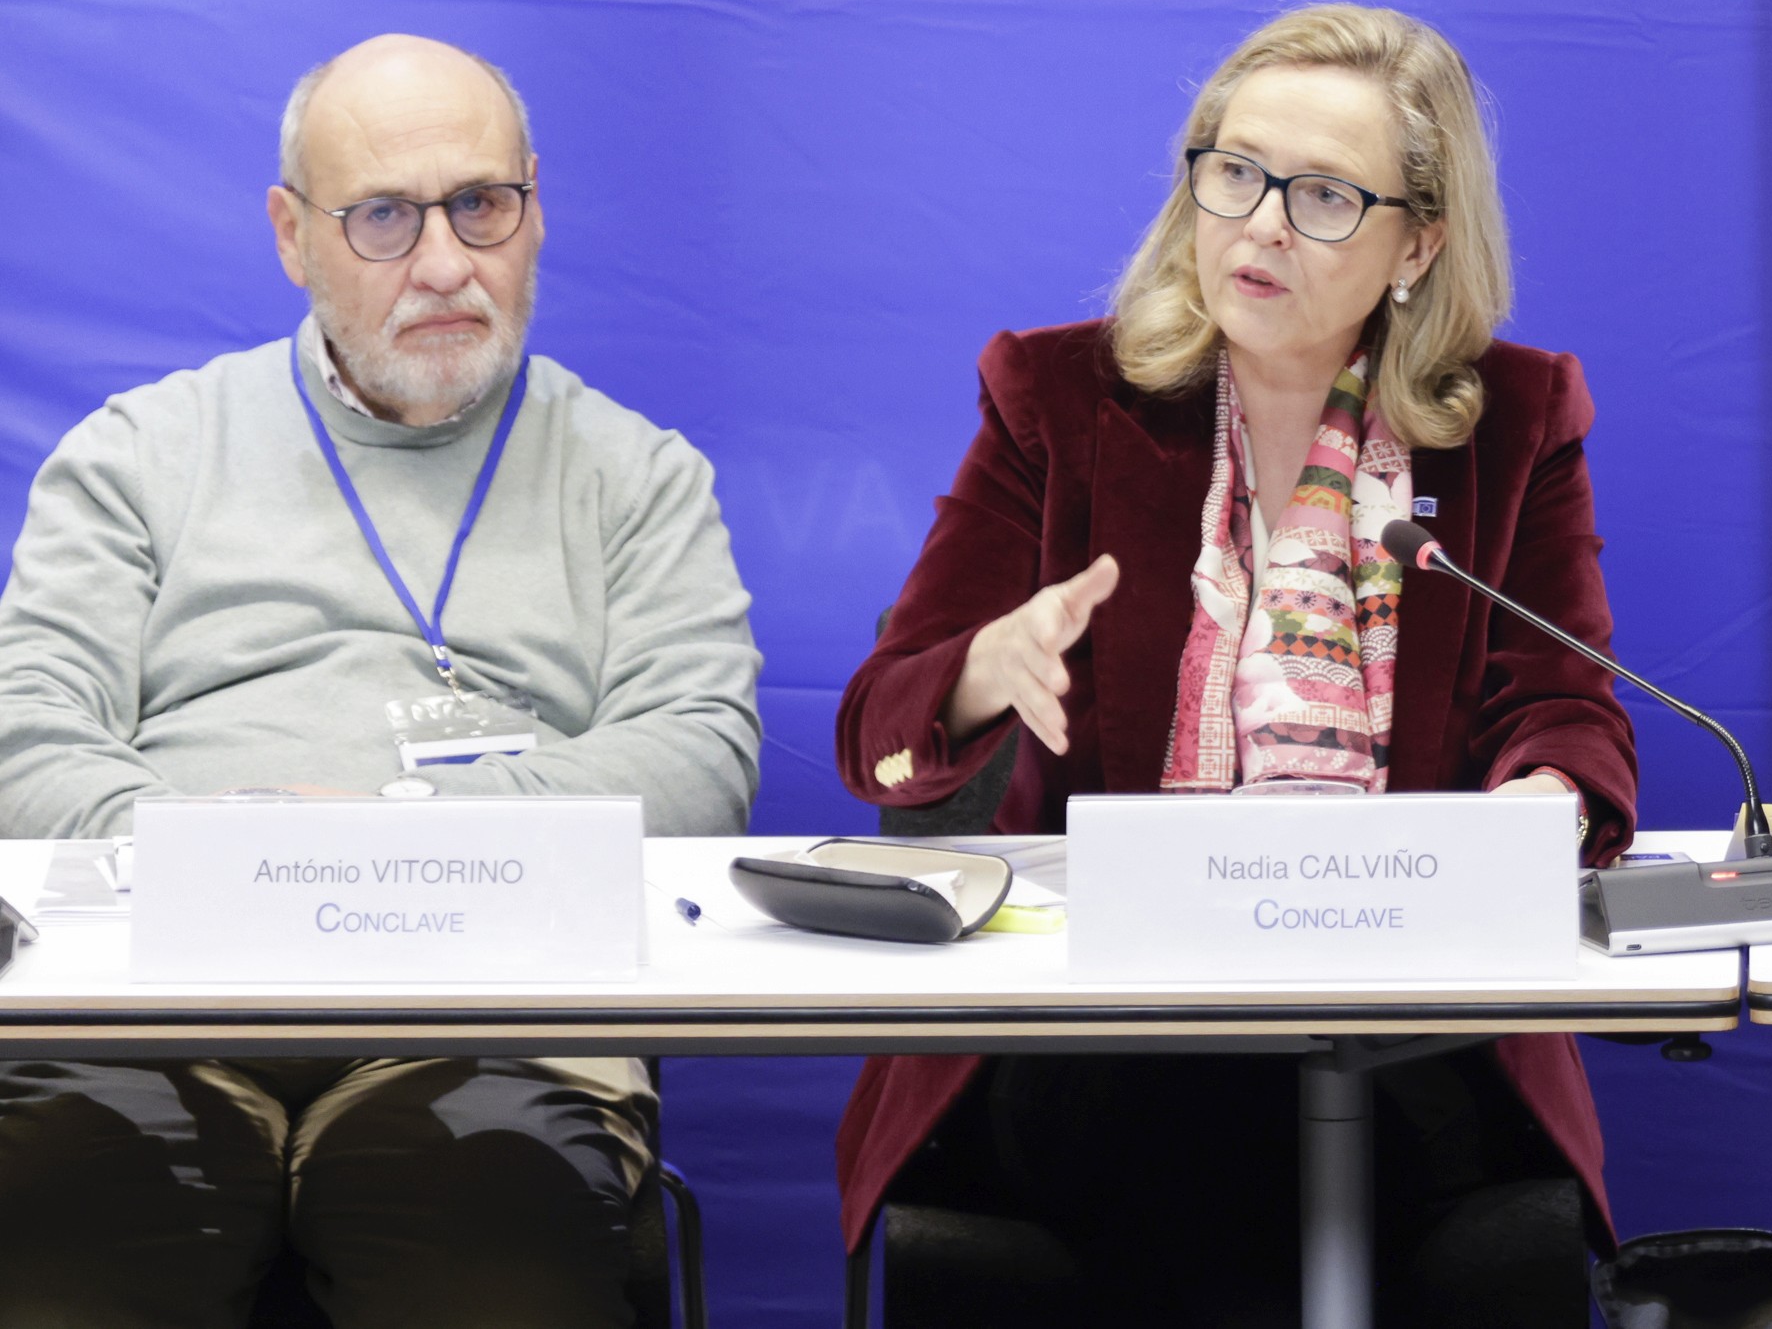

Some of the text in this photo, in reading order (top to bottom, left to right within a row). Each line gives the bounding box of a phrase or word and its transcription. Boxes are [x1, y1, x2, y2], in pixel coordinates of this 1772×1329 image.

[253, 858, 524, 885] António VITORINO
[1207, 848, 1438, 880] Nadia CALVIÑO
[315, 903, 466, 934] CONCLAVE
[1253, 898, 1405, 930] CONCLAVE
